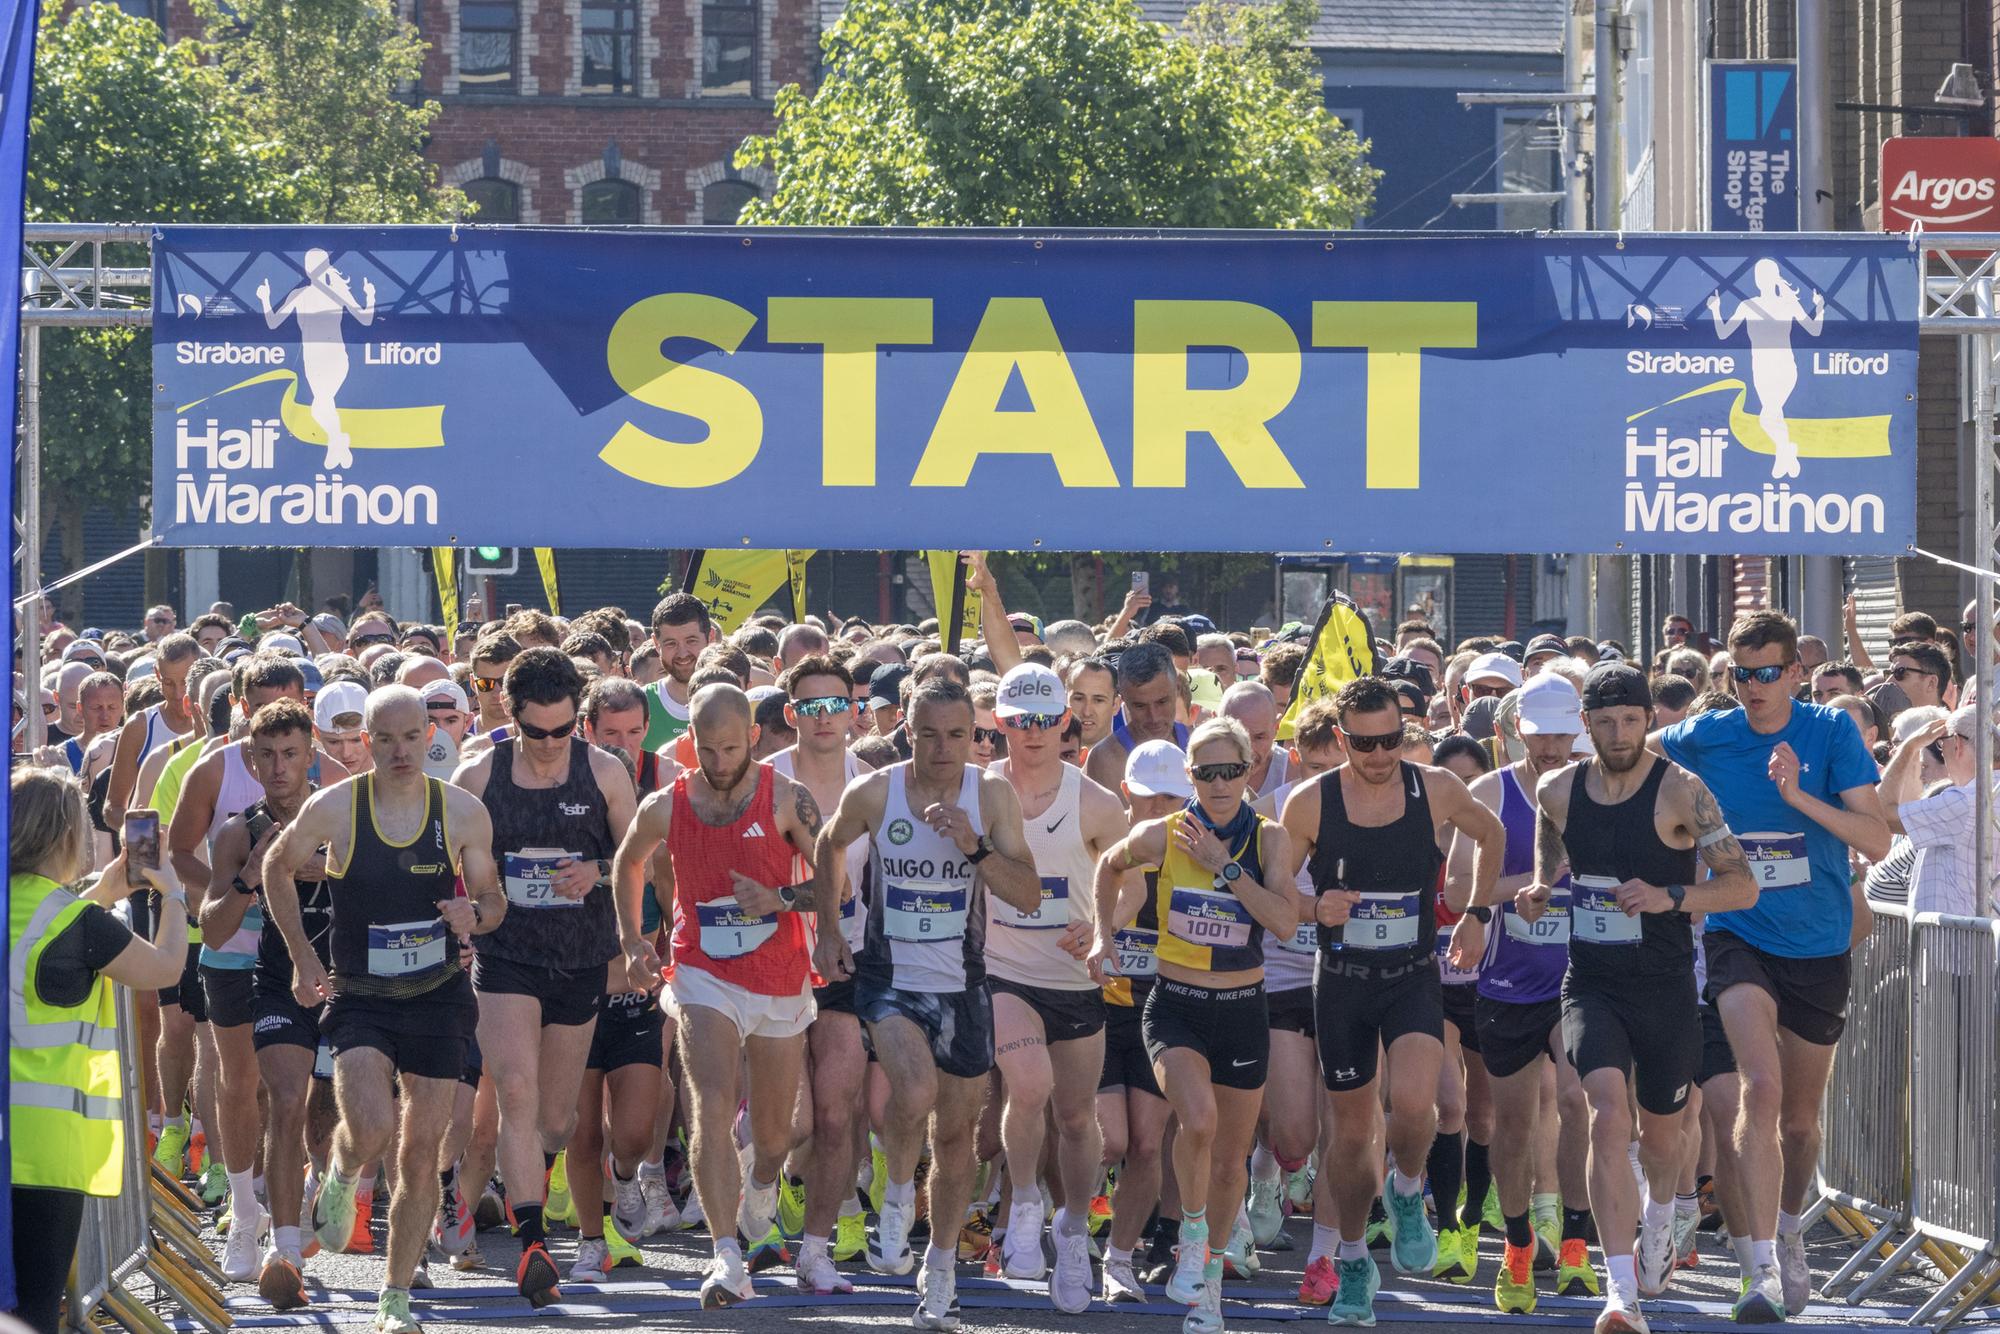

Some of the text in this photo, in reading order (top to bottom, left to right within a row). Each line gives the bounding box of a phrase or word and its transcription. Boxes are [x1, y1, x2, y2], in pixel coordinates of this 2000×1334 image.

[1724, 151, 1746, 209] Shop
[1771, 151, 1789, 194] The
[1891, 171, 1995, 209] Argos
[176, 342, 285, 365] Strabane
[365, 342, 441, 365] Lifford
[1626, 350, 1735, 374] Strabane
[1813, 352, 1889, 375] Lifford
[599, 292, 1478, 489] START
[176, 418, 281, 469] Half
[1626, 427, 1728, 478] Half
[176, 473, 438, 524] Marathon
[1625, 482, 1885, 533] Marathon
[721, 587, 751, 599] MARATHON
[1008, 680, 1052, 698] ciele
[435, 820, 443, 850] 2XU
[884, 857, 970, 879] SLIGO A.C.
[1764, 865, 1776, 880] 2
[527, 884, 557, 898] 27
[919, 918, 931, 932] 6
[1206, 911, 1237, 921] Marathon
[1595, 916, 1606, 933] 5
[1187, 920, 1230, 938] 1001
[1376, 924, 1387, 939] 8
[1529, 921, 1560, 937] 107
[734, 931, 742, 948] 1
[402, 951, 417, 966] 11
[1165, 983, 1208, 1000] NIKE PRO
[1216, 988, 1256, 1000] NIKE PRO
[998, 1040, 1020, 1056] BORN
[1021, 1037, 1034, 1046] TO
